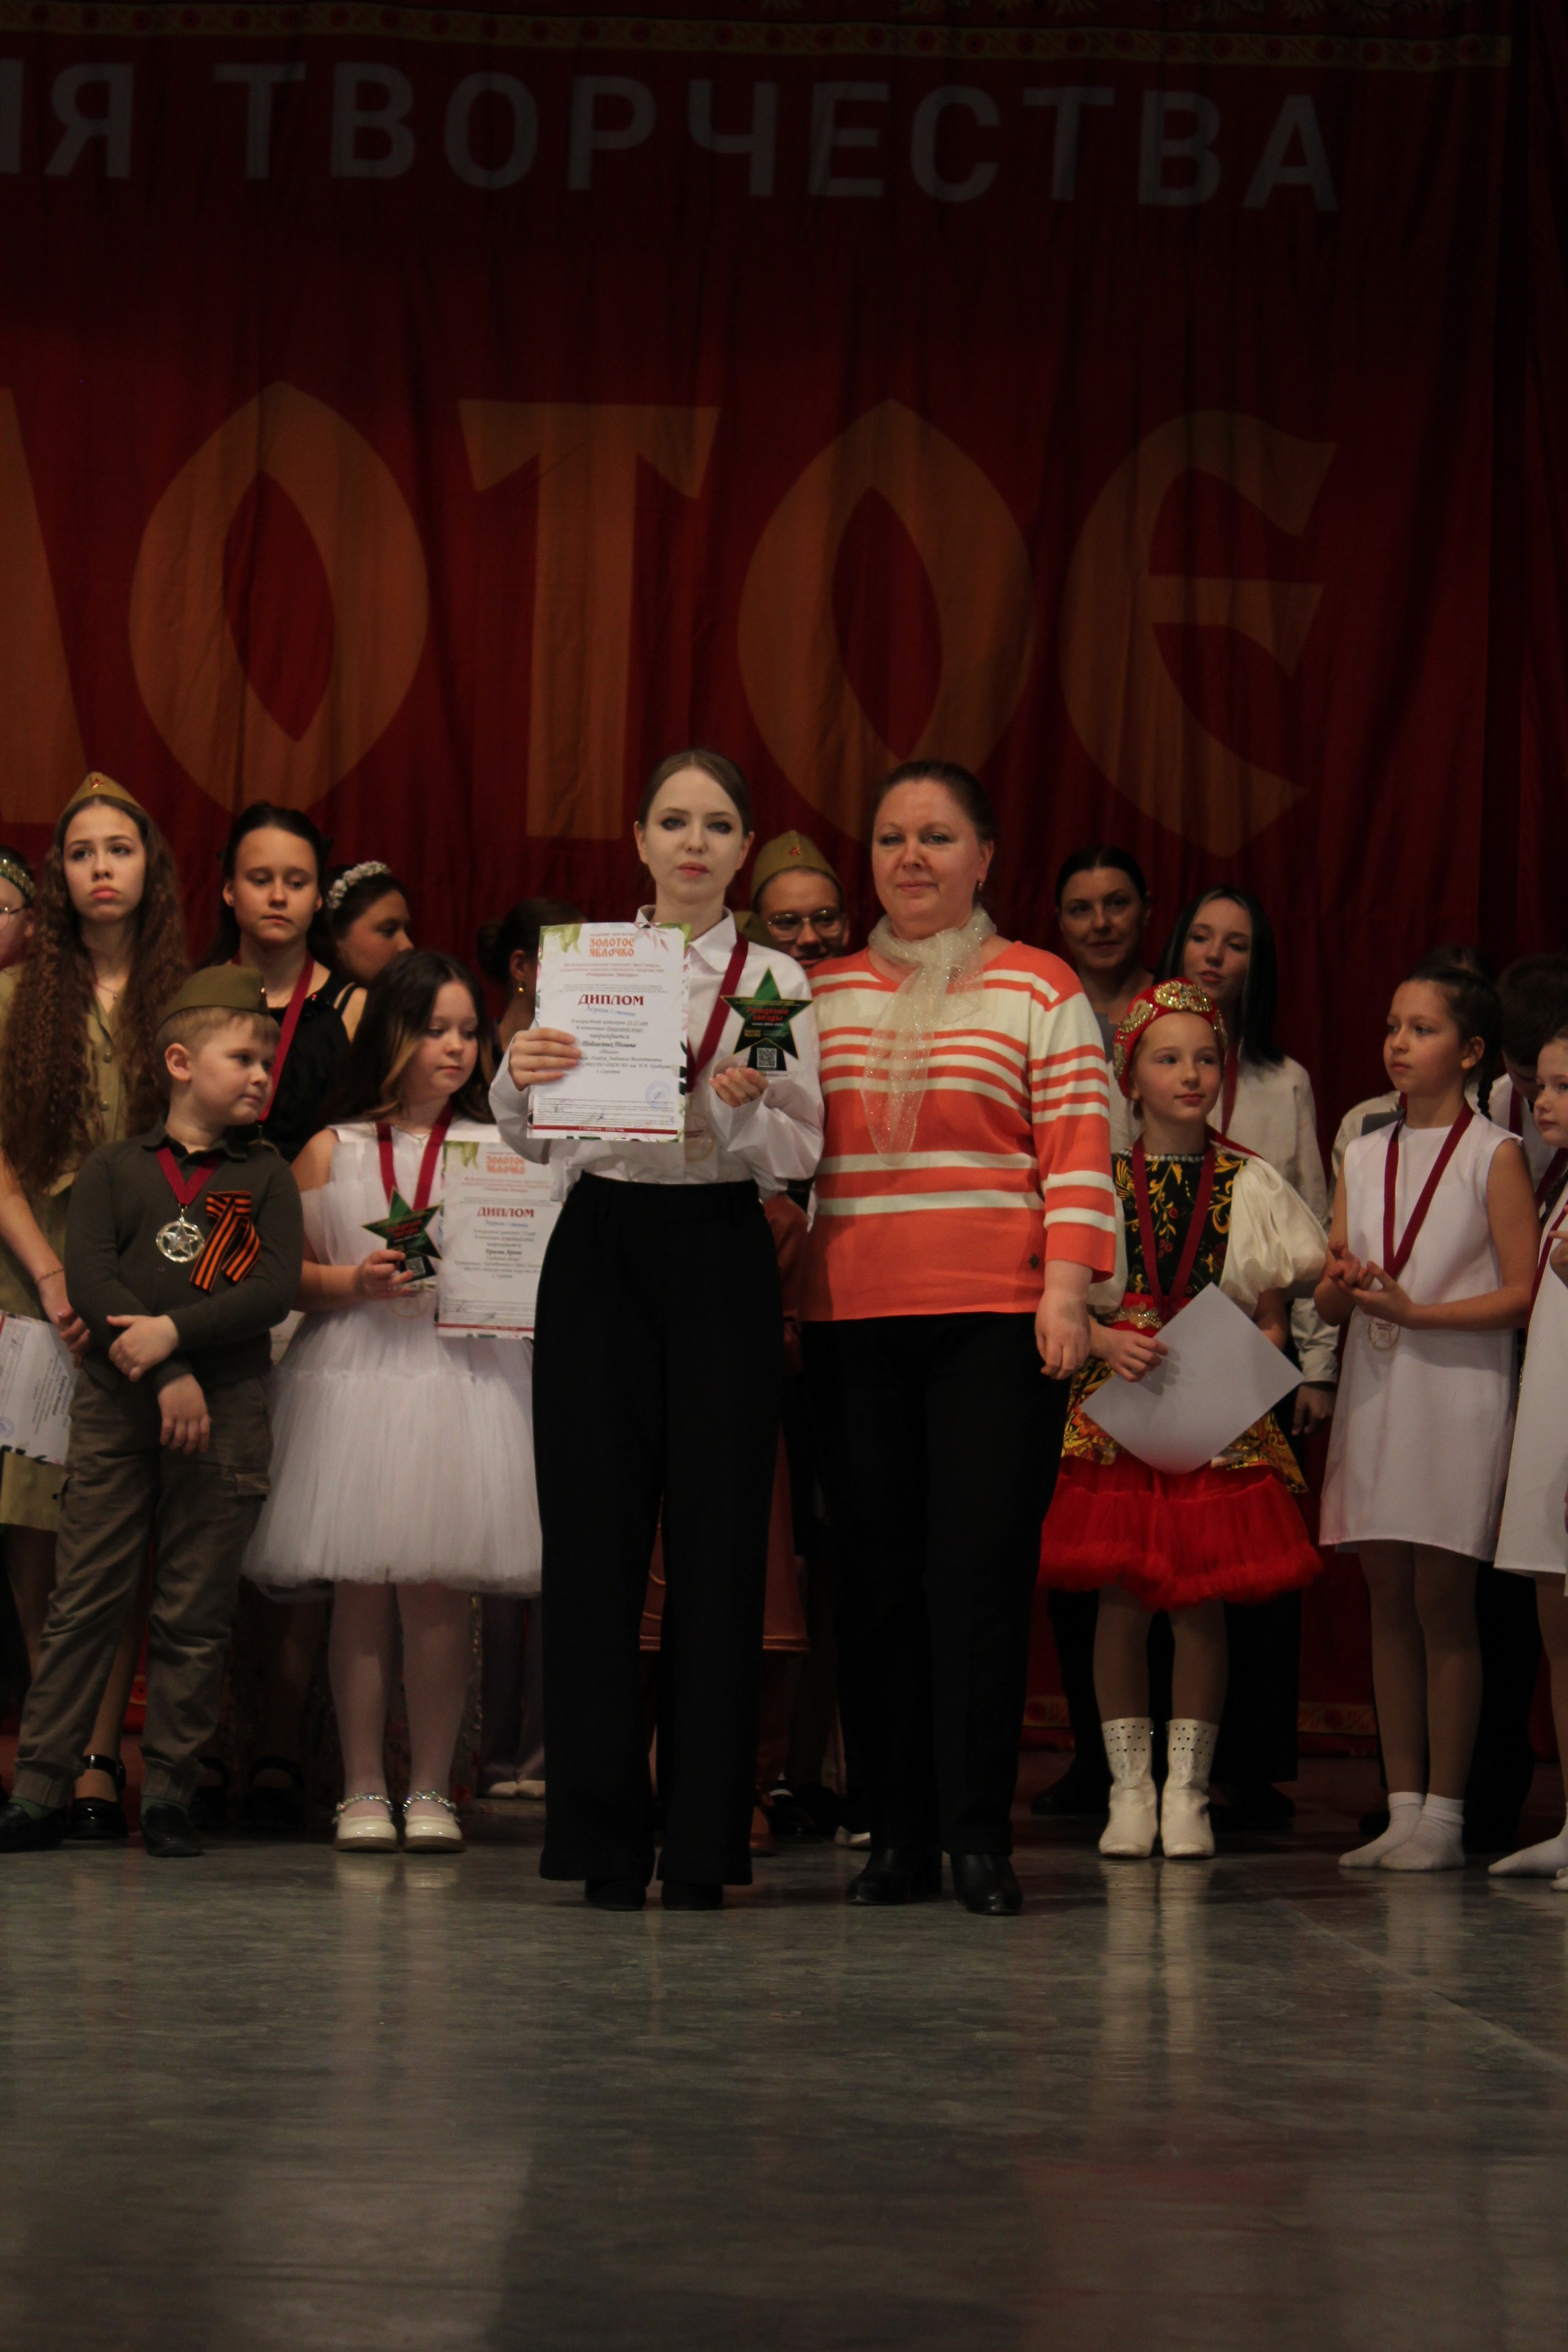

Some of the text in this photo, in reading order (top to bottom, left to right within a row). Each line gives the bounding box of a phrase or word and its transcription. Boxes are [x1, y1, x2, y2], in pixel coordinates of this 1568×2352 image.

[214, 62, 1338, 212] ТВОРЧЕСТВА
[589, 938, 634, 947] ЗОЛОТОЕ
[589, 948, 634, 957] ЯБЛОЧКО
[577, 994, 644, 1006] ДИПЛОМ
[747, 1007, 789, 1016] Рождение
[752, 1015, 783, 1023] звезды
[477, 1207, 534, 1218] ДИПЛОМ
